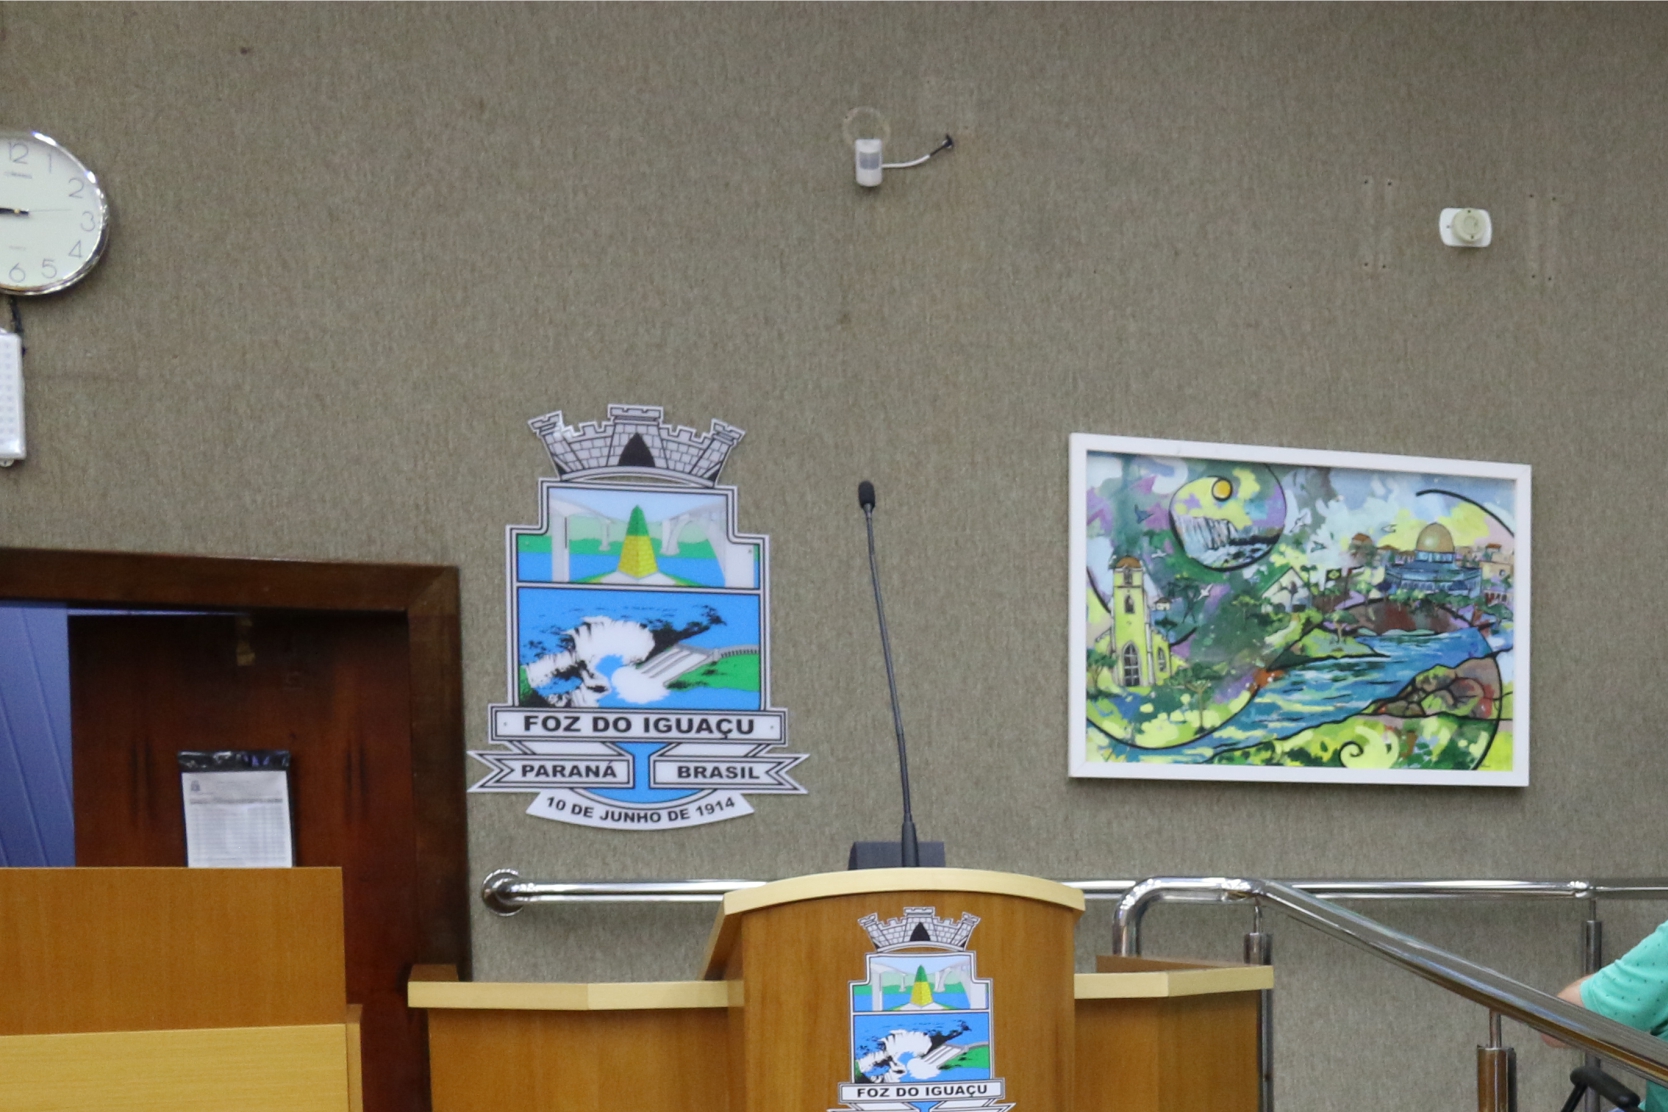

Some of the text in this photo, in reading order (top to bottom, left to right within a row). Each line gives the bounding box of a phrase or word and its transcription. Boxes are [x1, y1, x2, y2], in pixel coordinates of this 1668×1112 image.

[7, 142, 29, 165] 12
[68, 177, 84, 199] 2
[80, 211, 96, 232] 3
[68, 240, 83, 258] 4
[8, 262, 26, 283] 6
[41, 258, 57, 279] 5
[523, 715, 755, 740] FOZ DO IGUAÇU
[521, 761, 760, 780] PARANÁ BRASIL
[546, 796, 736, 824] 10 DE JUNHO DE 1914
[857, 1084, 988, 1098] FOZ DO IGUAÇU
